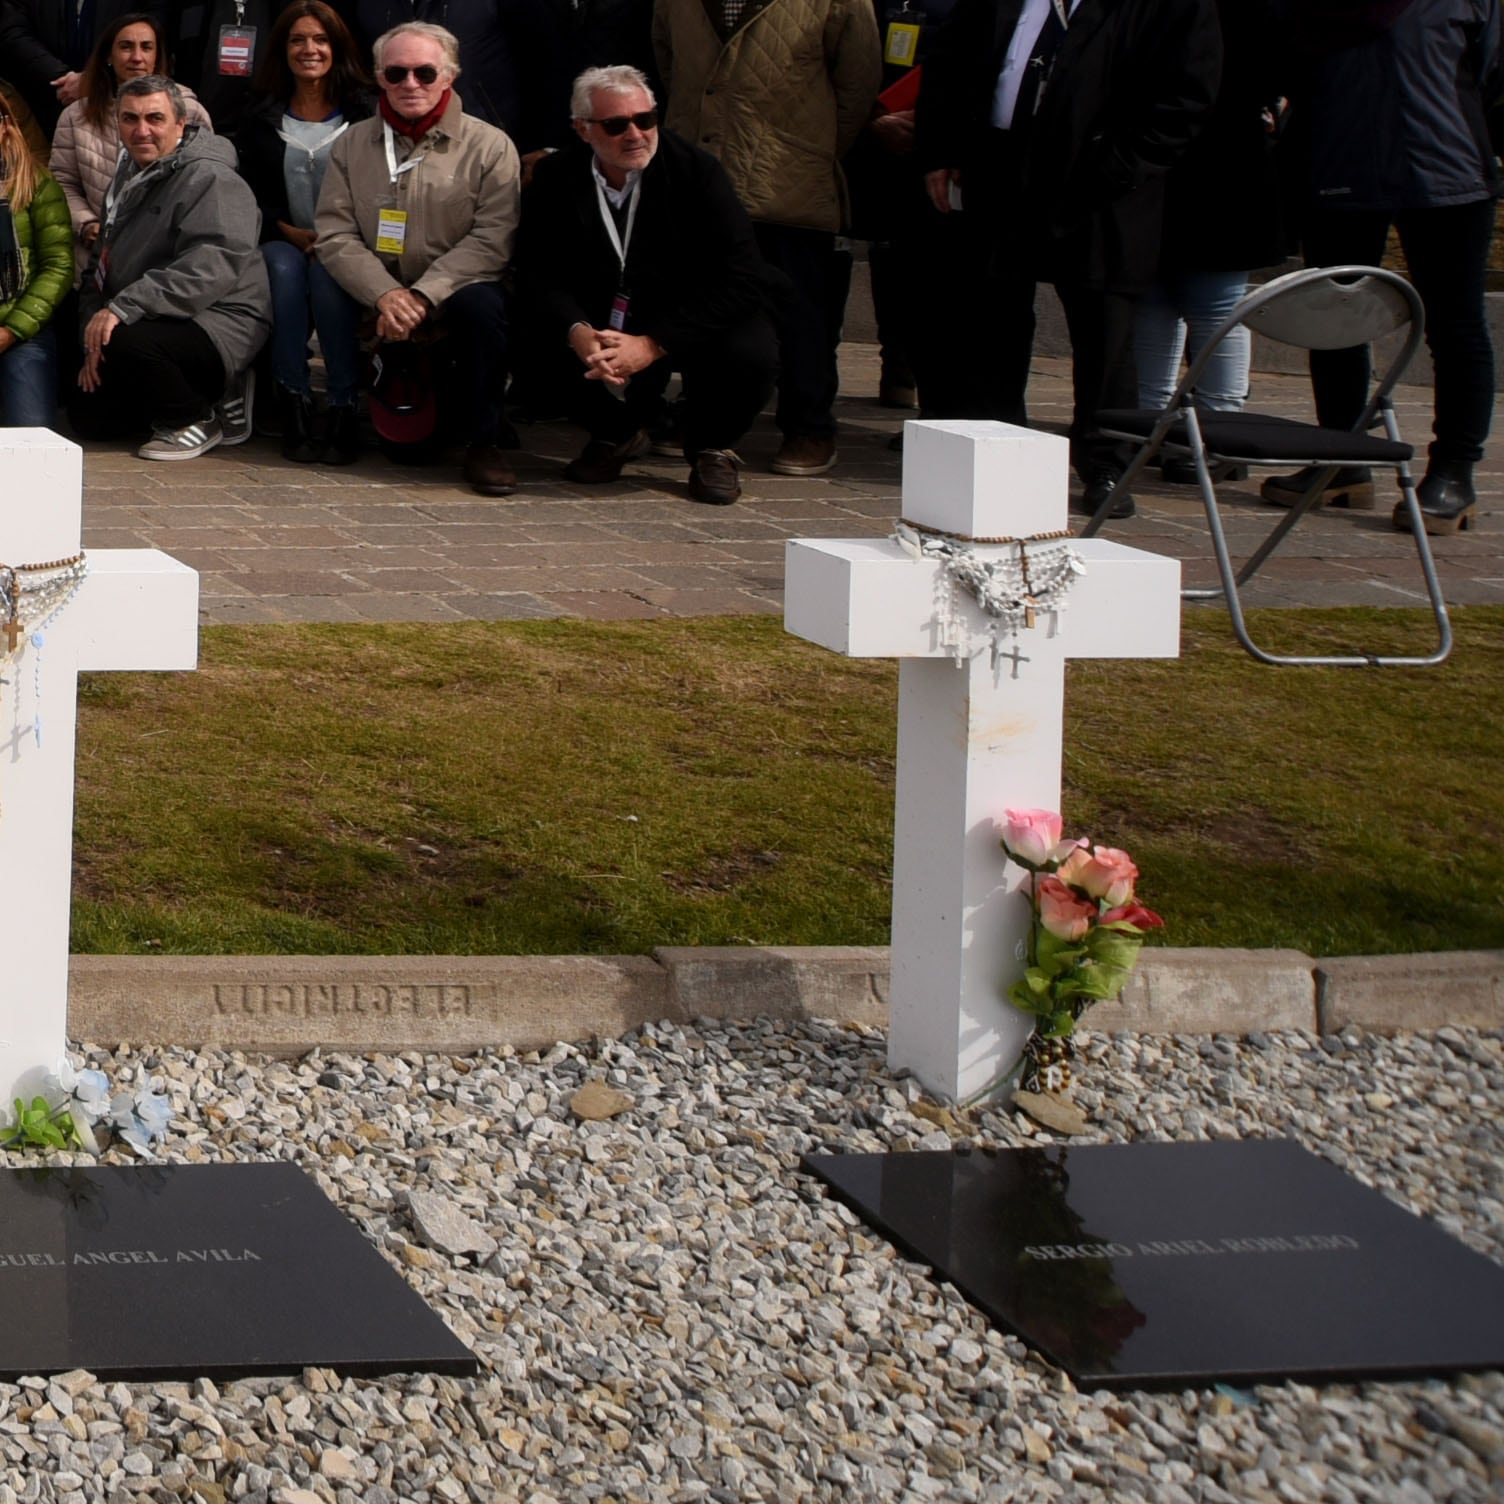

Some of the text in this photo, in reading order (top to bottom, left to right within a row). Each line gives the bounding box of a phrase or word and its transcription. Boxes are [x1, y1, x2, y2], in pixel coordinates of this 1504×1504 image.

[211, 984, 471, 1017] ELECTRICITY
[72, 1249, 169, 1265] ANGEL
[175, 1248, 263, 1263] AVILA
[1024, 1242, 1134, 1261] SERGIO
